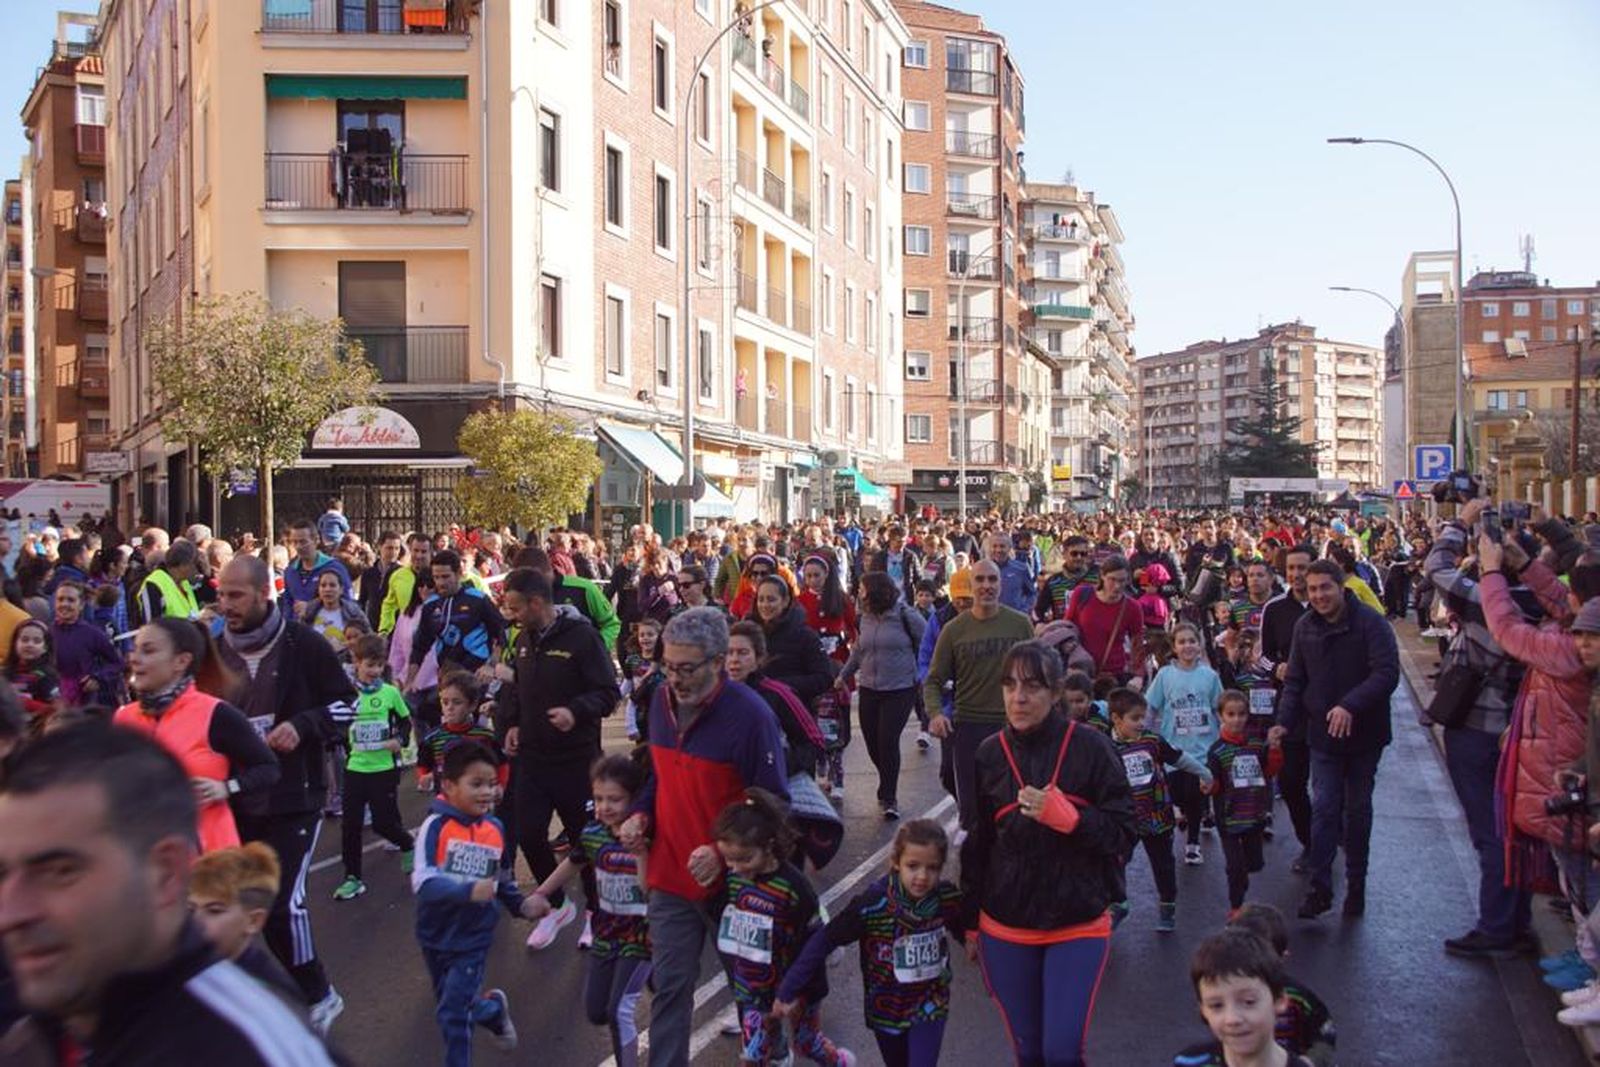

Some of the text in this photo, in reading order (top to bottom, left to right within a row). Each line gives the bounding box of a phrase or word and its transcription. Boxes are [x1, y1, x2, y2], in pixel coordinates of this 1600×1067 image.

[1422, 449, 1445, 477] P
[451, 851, 489, 877] 5999
[905, 942, 940, 966] 6148
